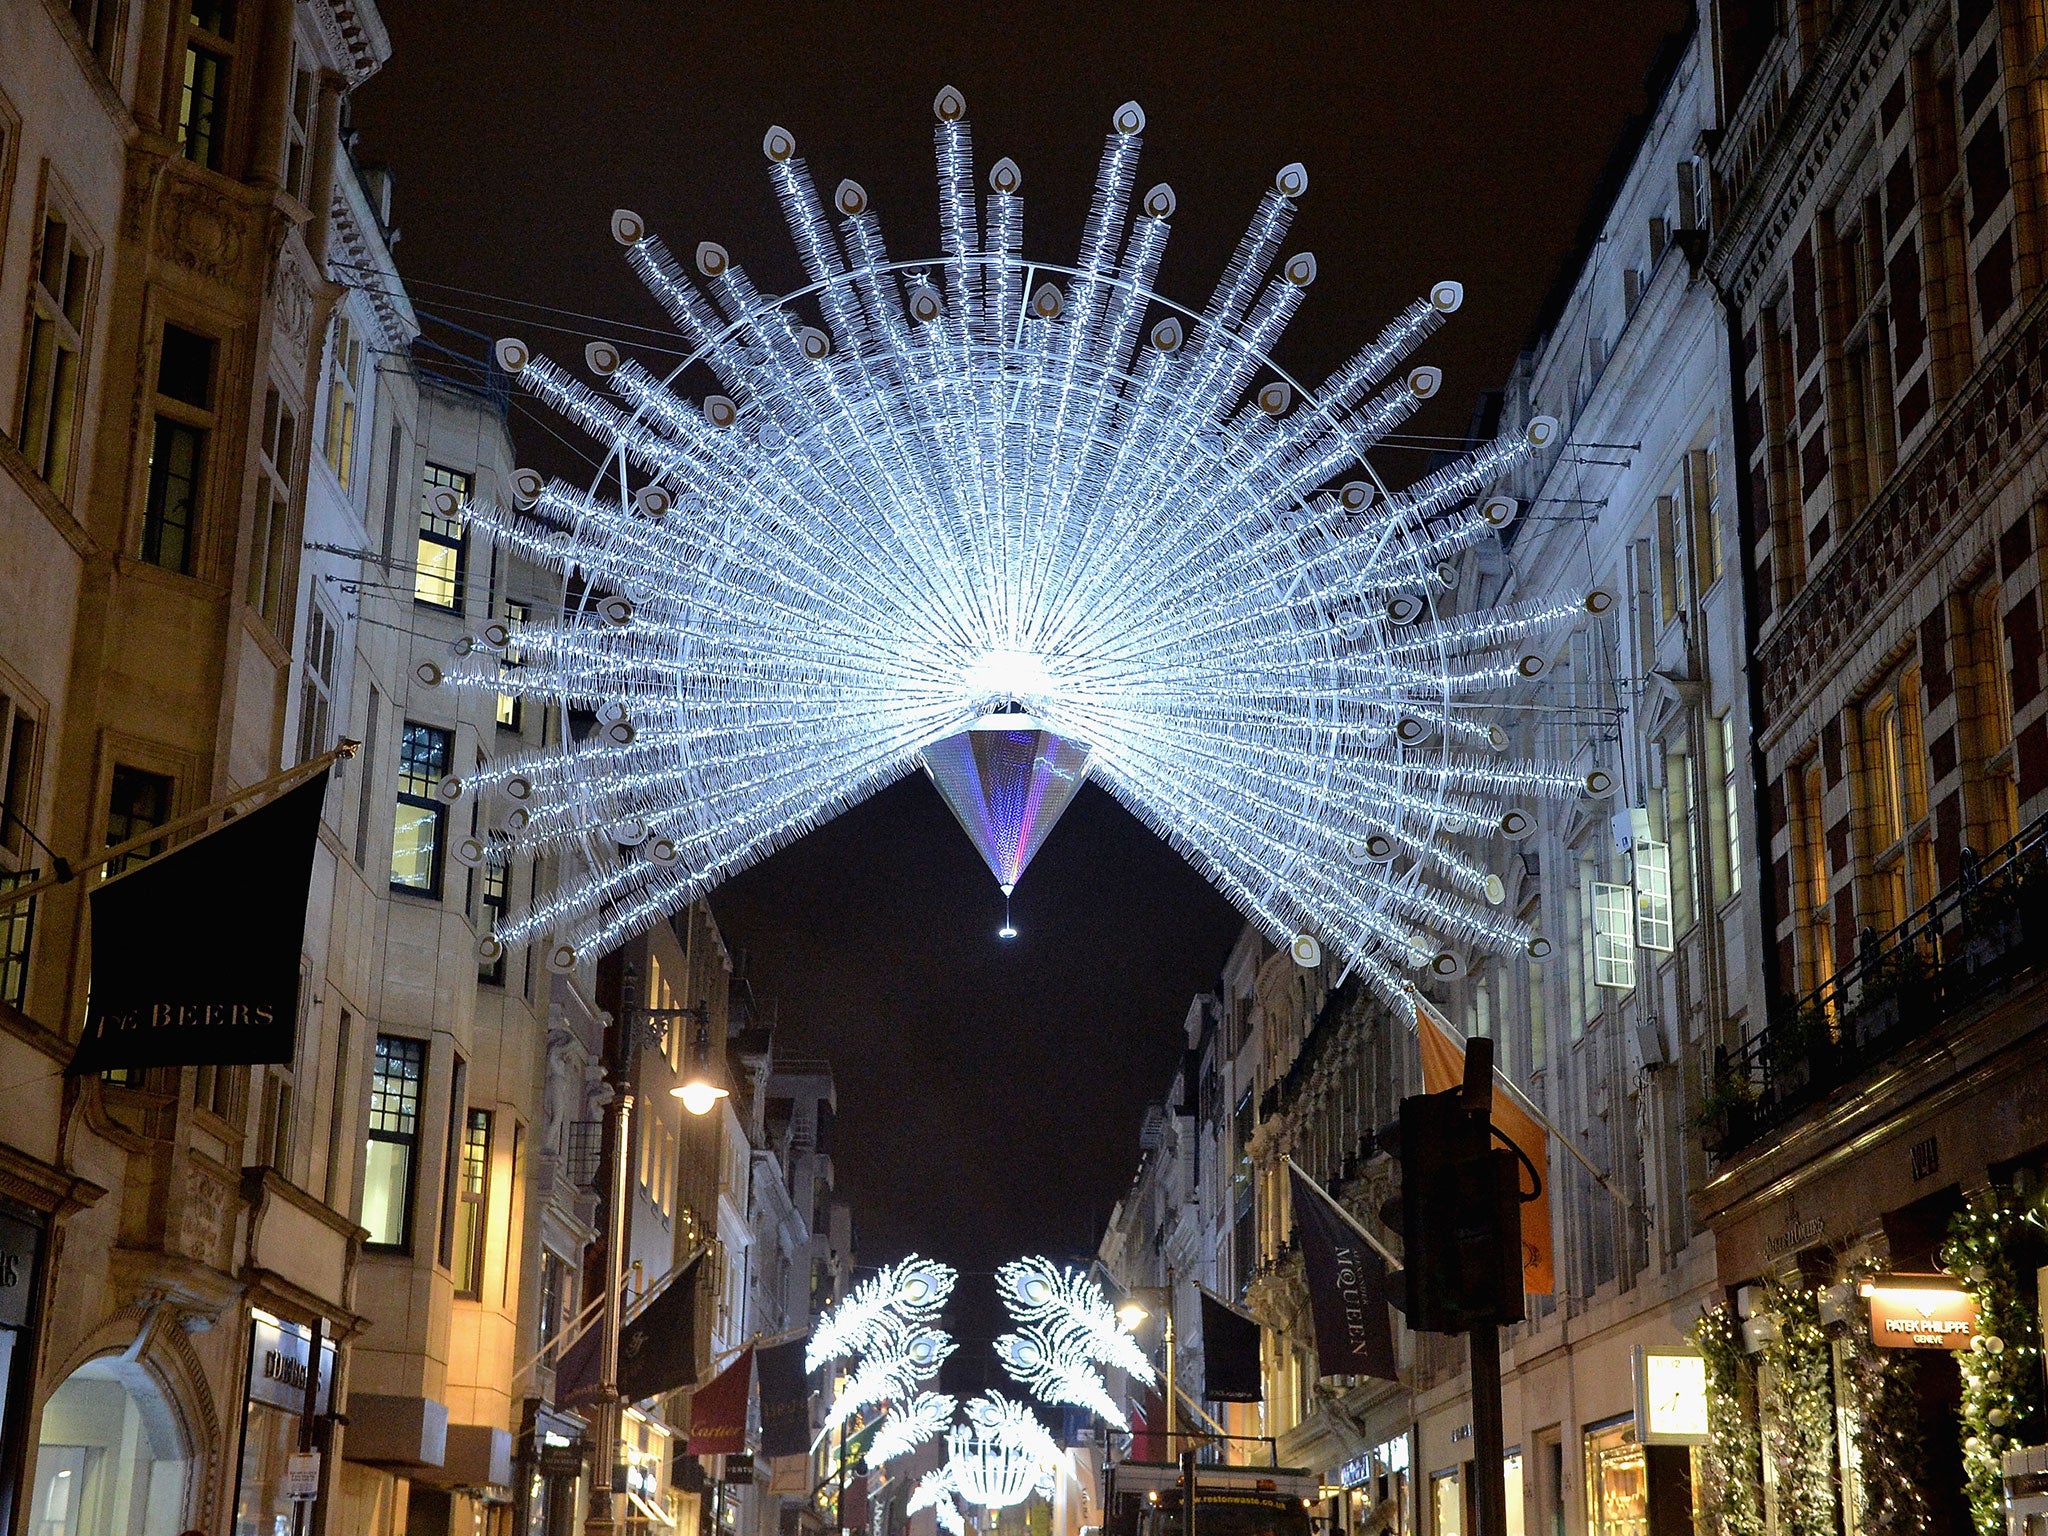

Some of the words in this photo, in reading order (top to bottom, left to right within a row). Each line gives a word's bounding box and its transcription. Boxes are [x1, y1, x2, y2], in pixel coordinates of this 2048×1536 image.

[152, 1003, 274, 1027] BEERS
[1885, 1319, 1920, 1333] PATEK
[1920, 1319, 1970, 1335] PHILIPPE
[691, 1423, 744, 1438] Cartier
[1179, 1496, 1287, 1511] ww.restonwaste.co.uk
